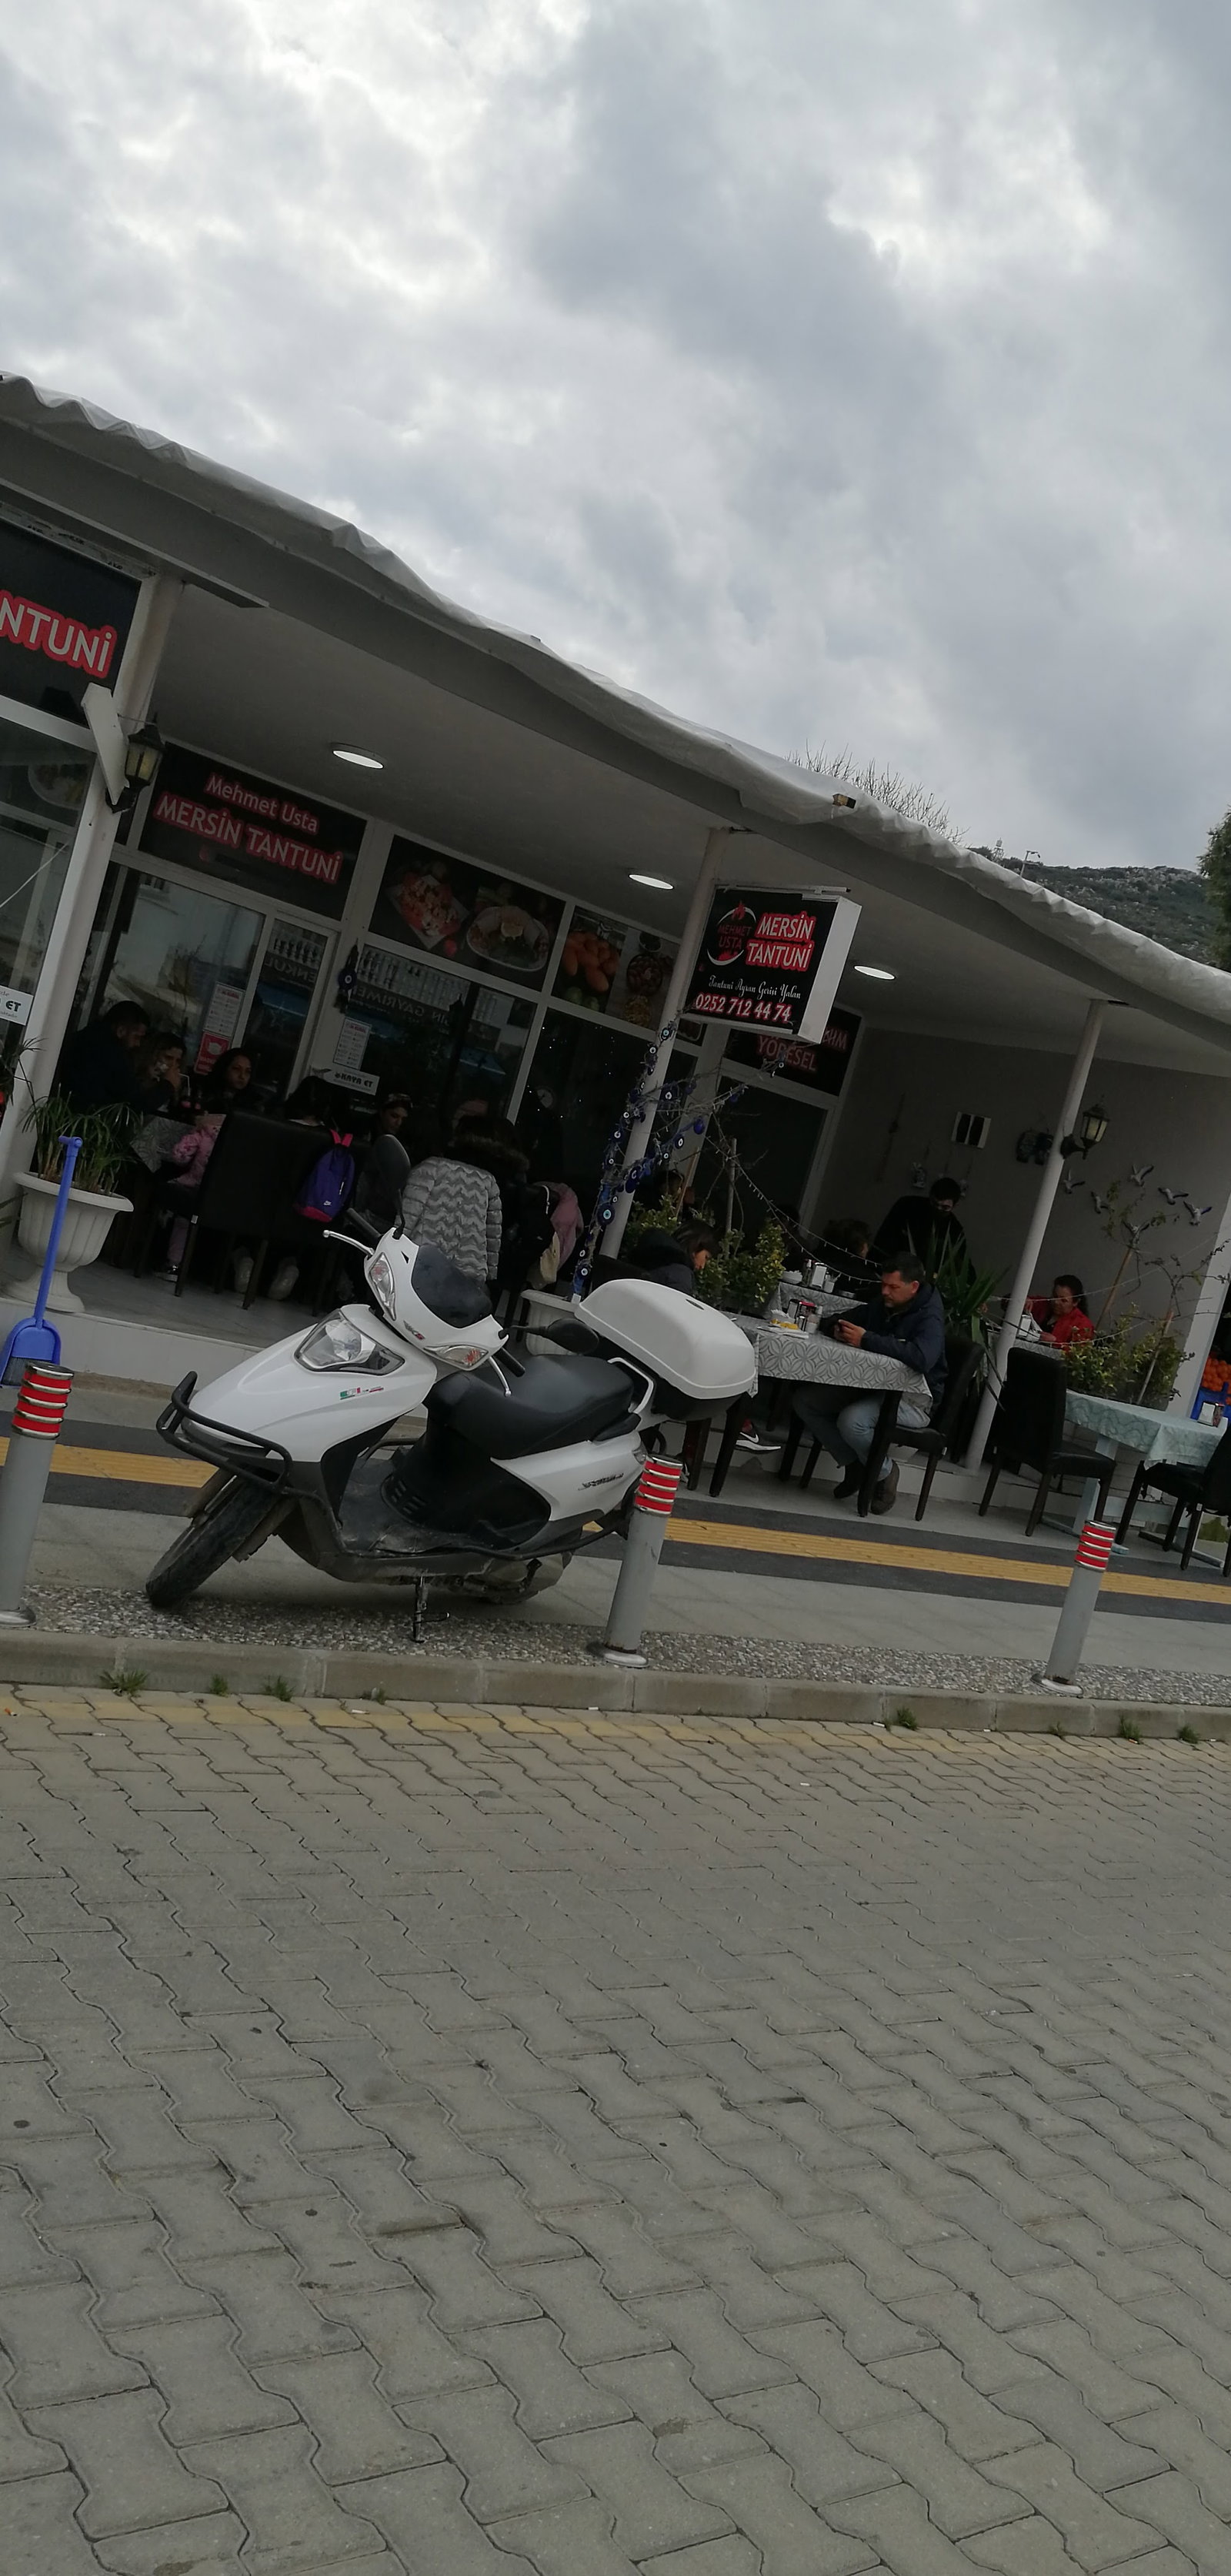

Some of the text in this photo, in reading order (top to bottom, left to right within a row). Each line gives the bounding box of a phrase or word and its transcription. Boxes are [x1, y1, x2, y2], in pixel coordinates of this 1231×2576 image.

[206, 774, 318, 832] Mehmet Usta
[157, 795, 341, 880] MERSİN TANTUNİ
[717, 924, 752, 937] MEHMET
[756, 914, 814, 940] MERSİN
[718, 936, 742, 949] USTA
[747, 942, 812, 968] TANTUNİ
[709, 975, 801, 1003] Tantuni Ayran Gerisi Yalan
[5, 1001, 22, 1012] ET
[696, 994, 792, 1022] 0252 712 44 74
[341, 1073, 362, 1085] KAYA
